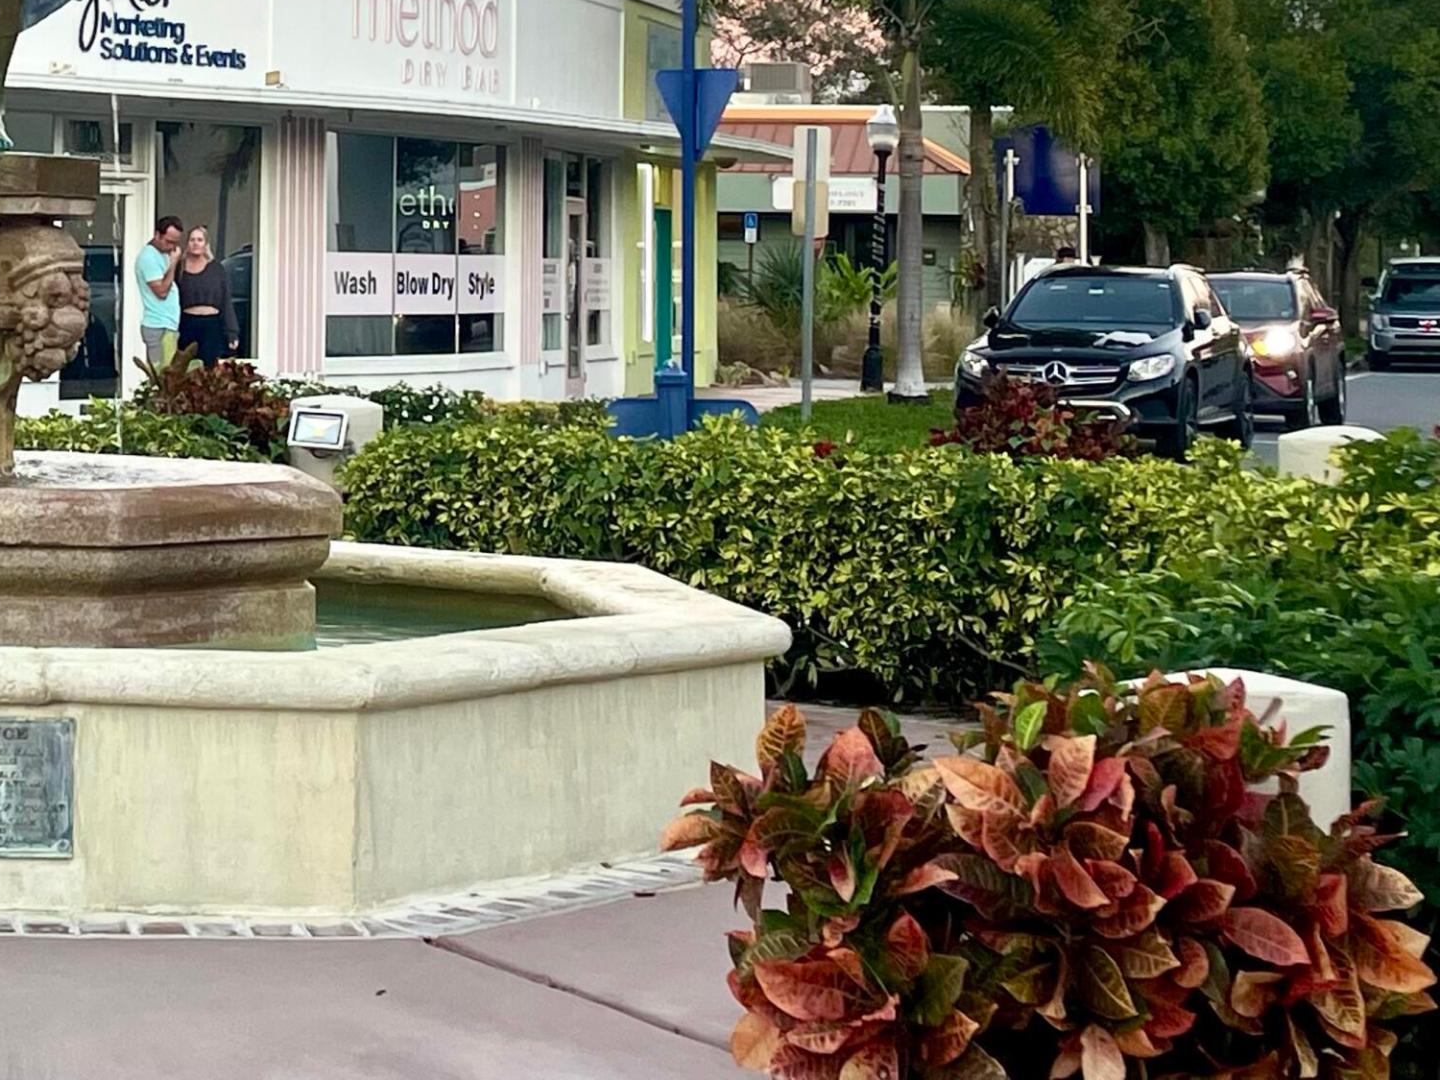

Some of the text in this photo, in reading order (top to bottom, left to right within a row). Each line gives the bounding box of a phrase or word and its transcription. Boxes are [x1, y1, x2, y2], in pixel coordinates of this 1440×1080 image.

[101, 12, 185, 44] Marketing
[100, 37, 246, 70] Solutions & Events
[401, 58, 449, 88] DRY
[422, 220, 450, 229] DRY
[334, 270, 495, 300] Wash Blow Dry Style
